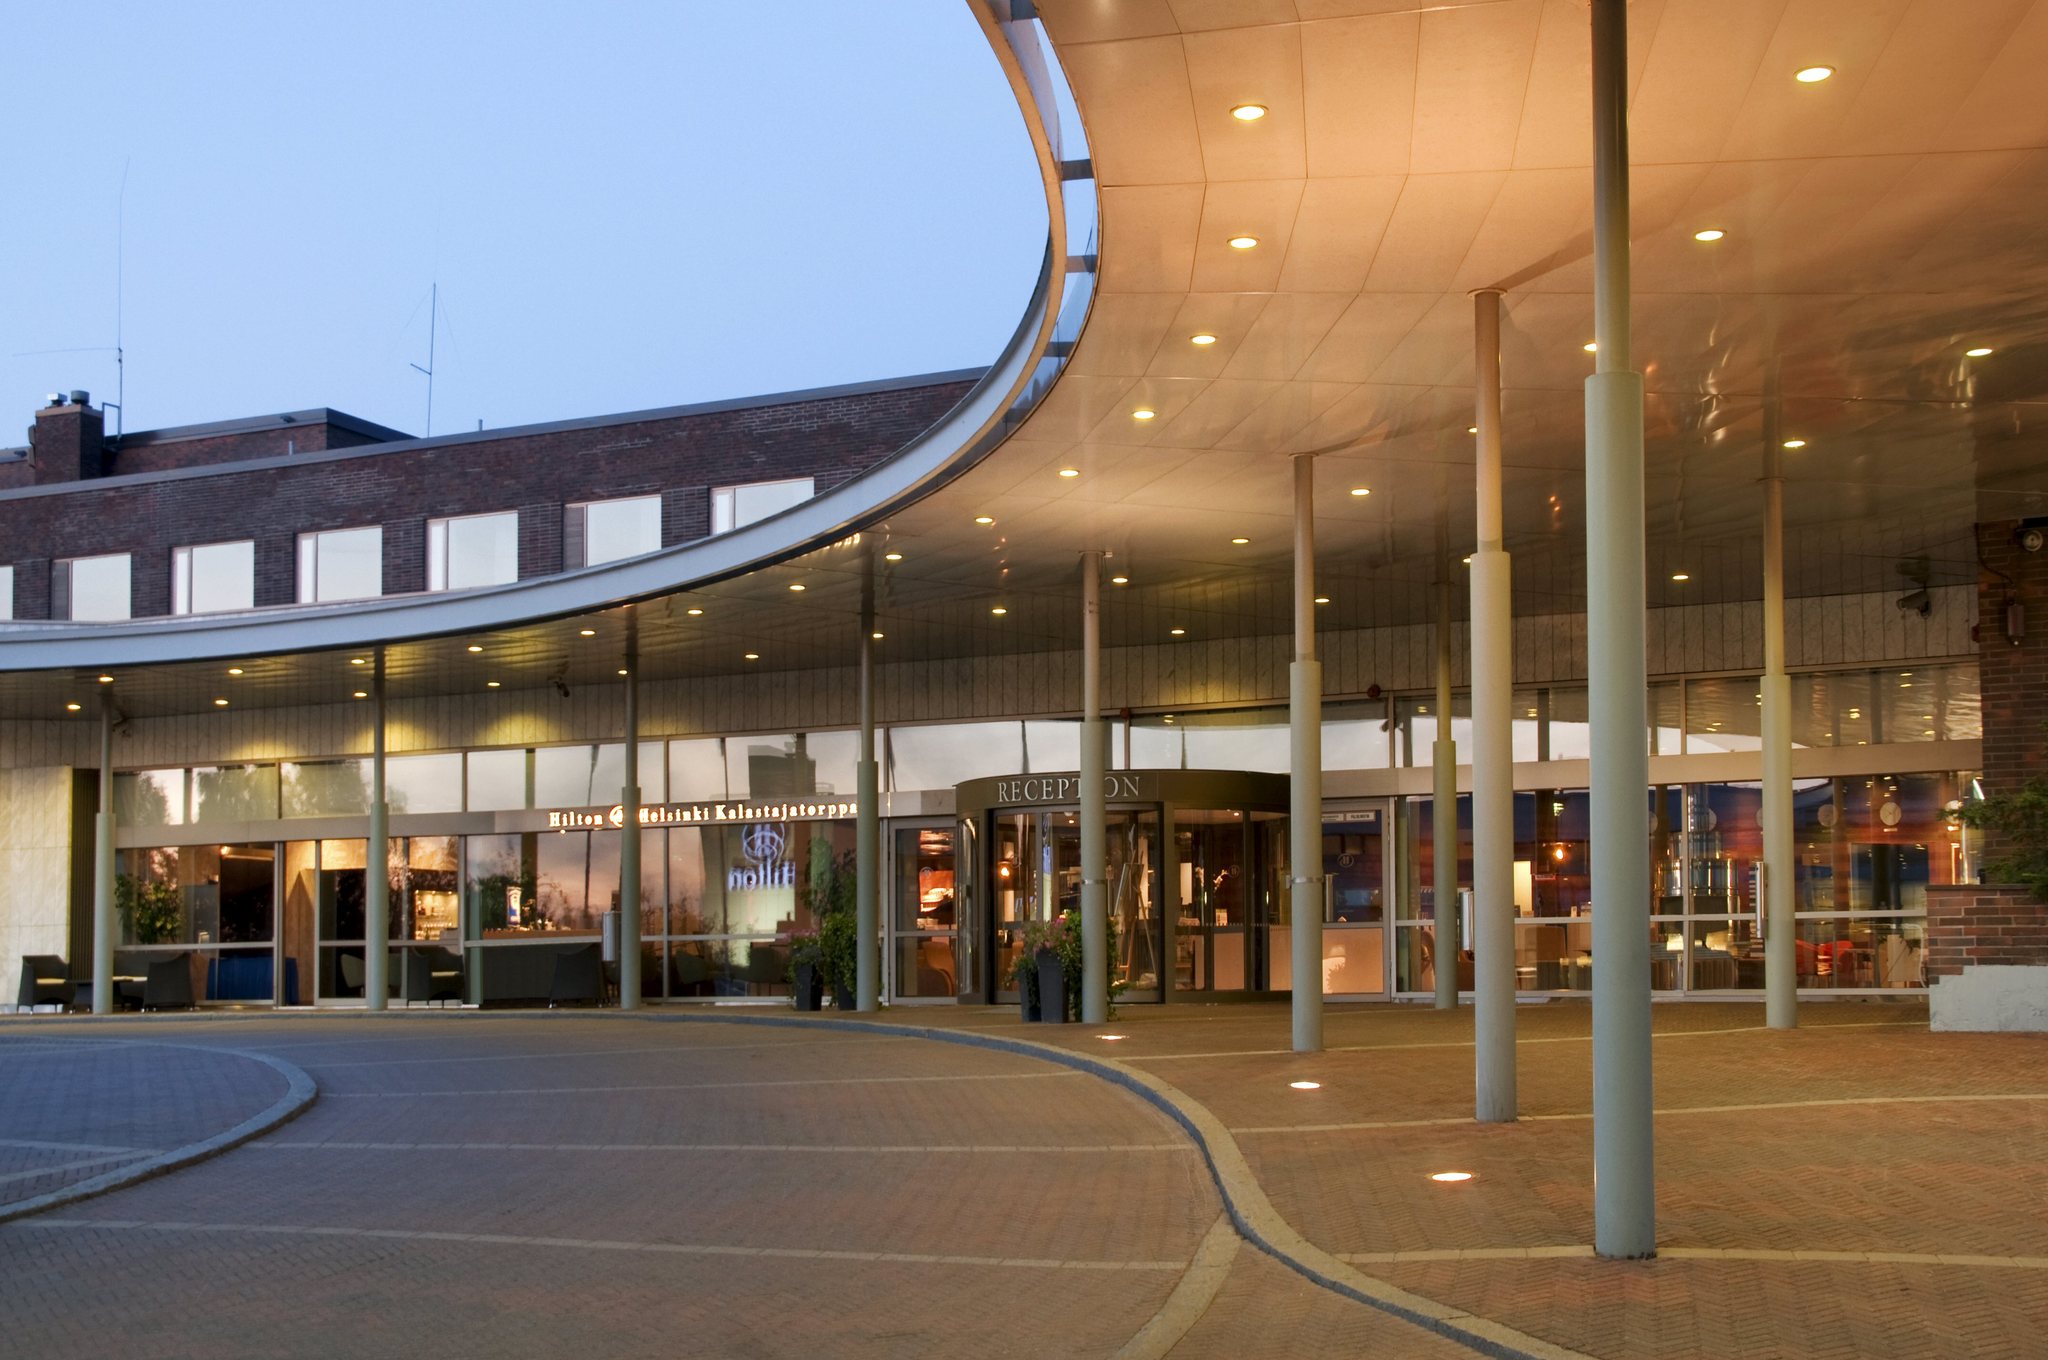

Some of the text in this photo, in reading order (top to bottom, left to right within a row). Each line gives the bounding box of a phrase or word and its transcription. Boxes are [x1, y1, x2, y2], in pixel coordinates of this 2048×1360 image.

[998, 776, 1140, 802] RECEPTON
[549, 802, 858, 827] Hilton Helsinki Kalastajatorppa
